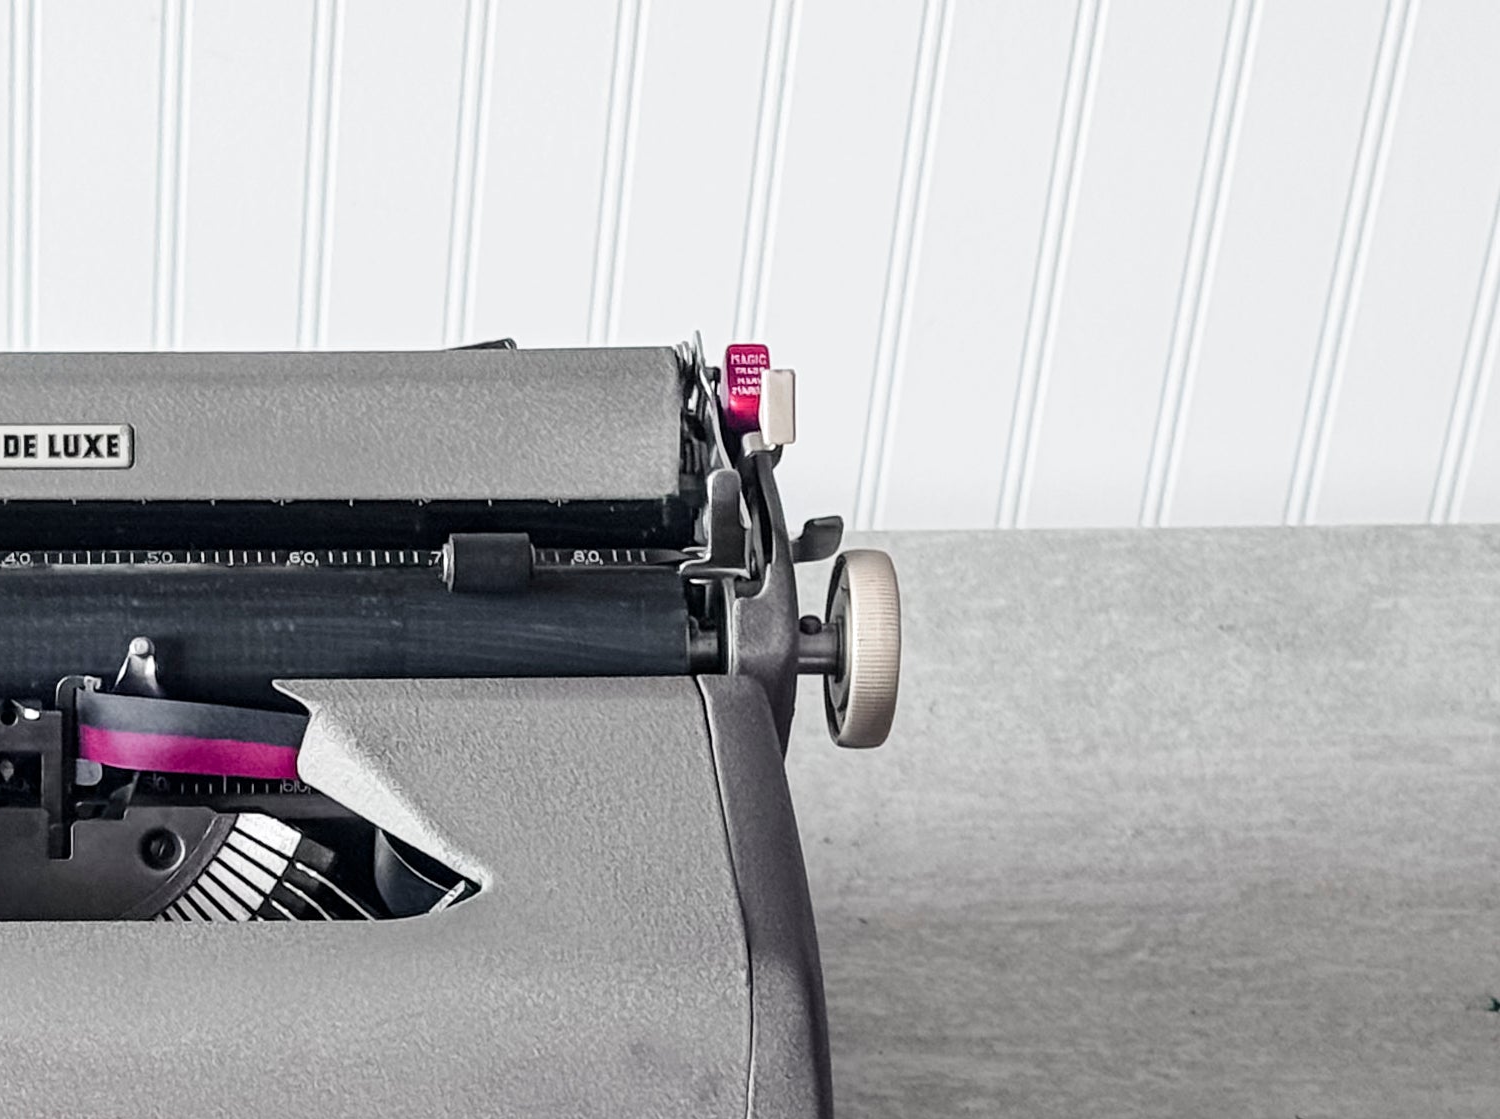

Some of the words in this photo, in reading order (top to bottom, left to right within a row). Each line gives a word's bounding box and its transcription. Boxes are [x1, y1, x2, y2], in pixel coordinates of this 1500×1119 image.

[730, 353, 767, 366] MAGIC
[3, 434, 36, 458] DE
[48, 434, 119, 458] LUXE
[4, 551, 32, 566] 40
[146, 550, 174, 564] 50
[288, 550, 316, 565] 60
[573, 549, 600, 563] 80
